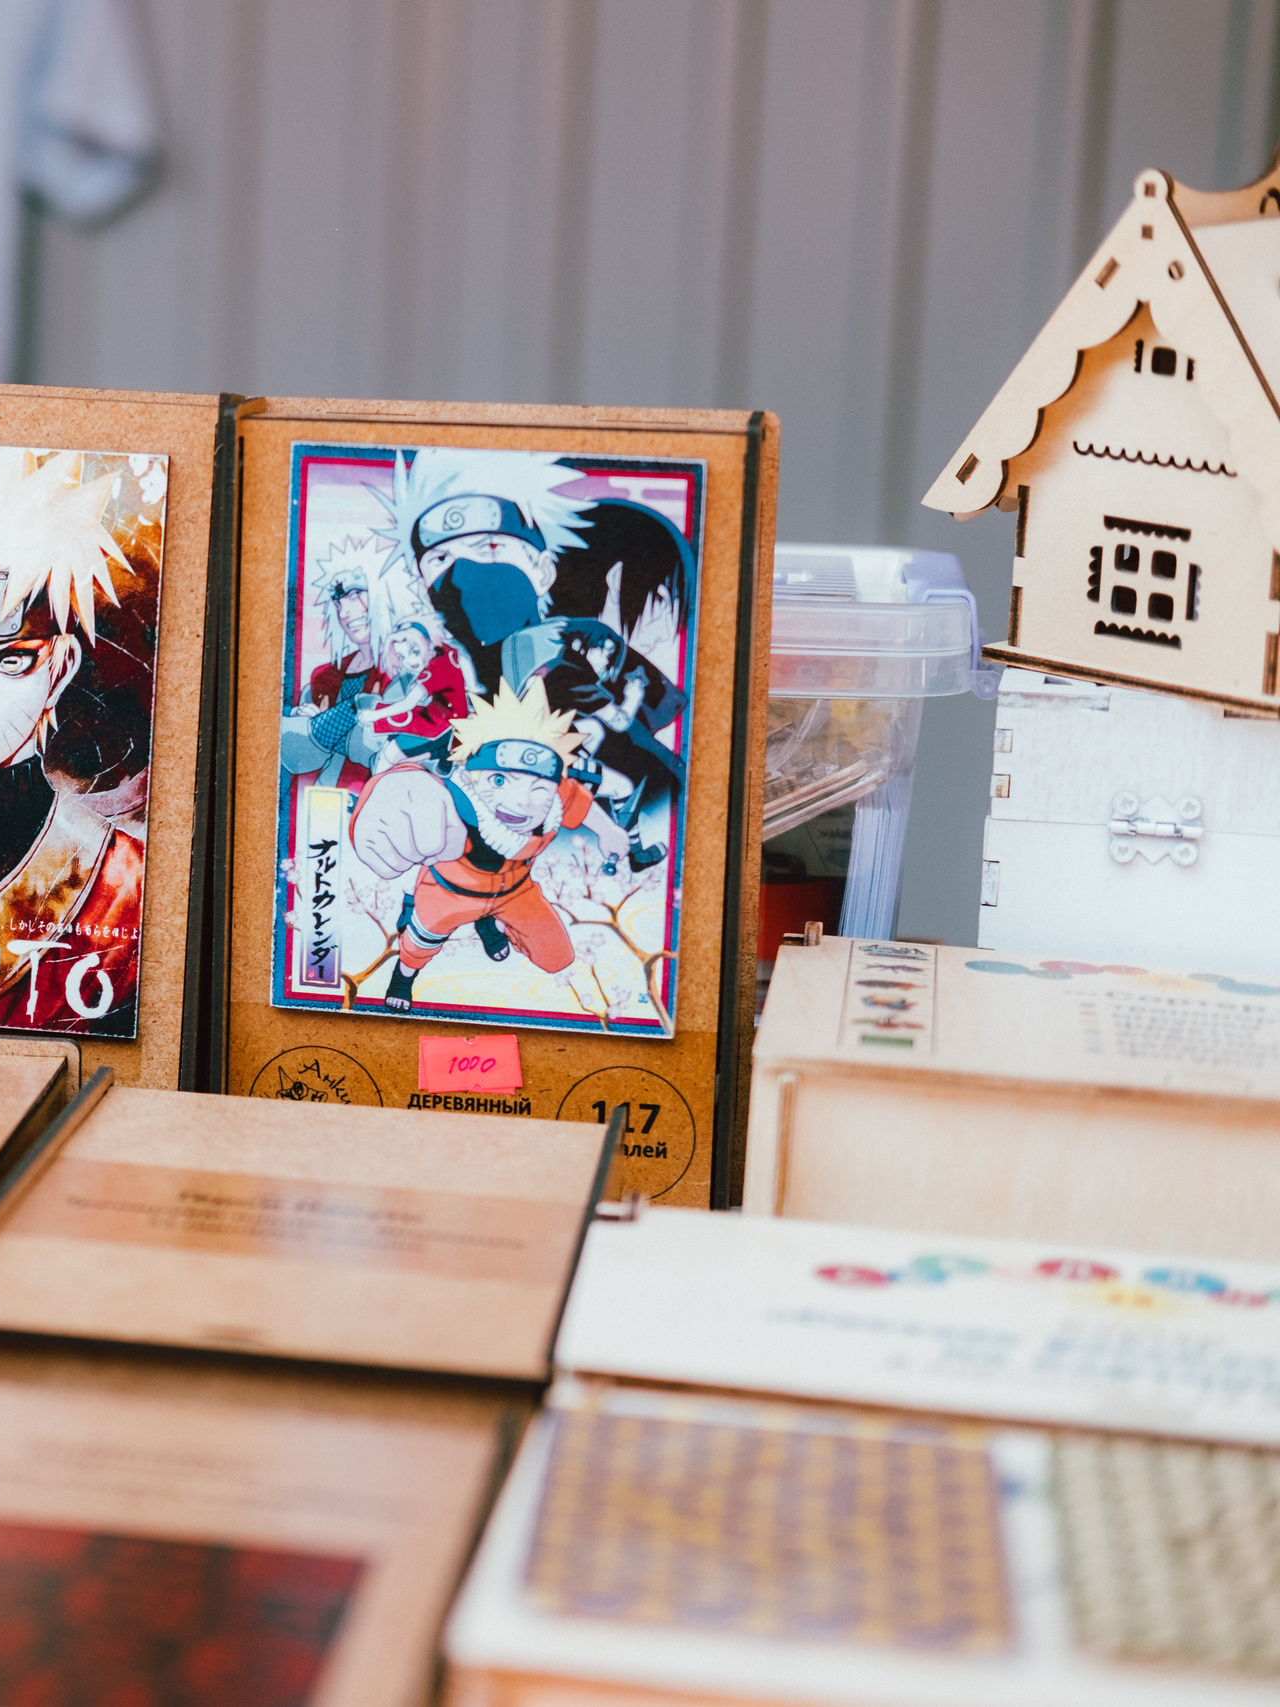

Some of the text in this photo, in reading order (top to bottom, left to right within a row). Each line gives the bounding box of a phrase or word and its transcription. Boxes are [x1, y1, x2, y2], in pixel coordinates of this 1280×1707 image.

[307, 838, 339, 979] ナルトカレンダー
[448, 1055, 497, 1074] 1000
[407, 1093, 532, 1116] ДЕРЕВЯННЫЙ
